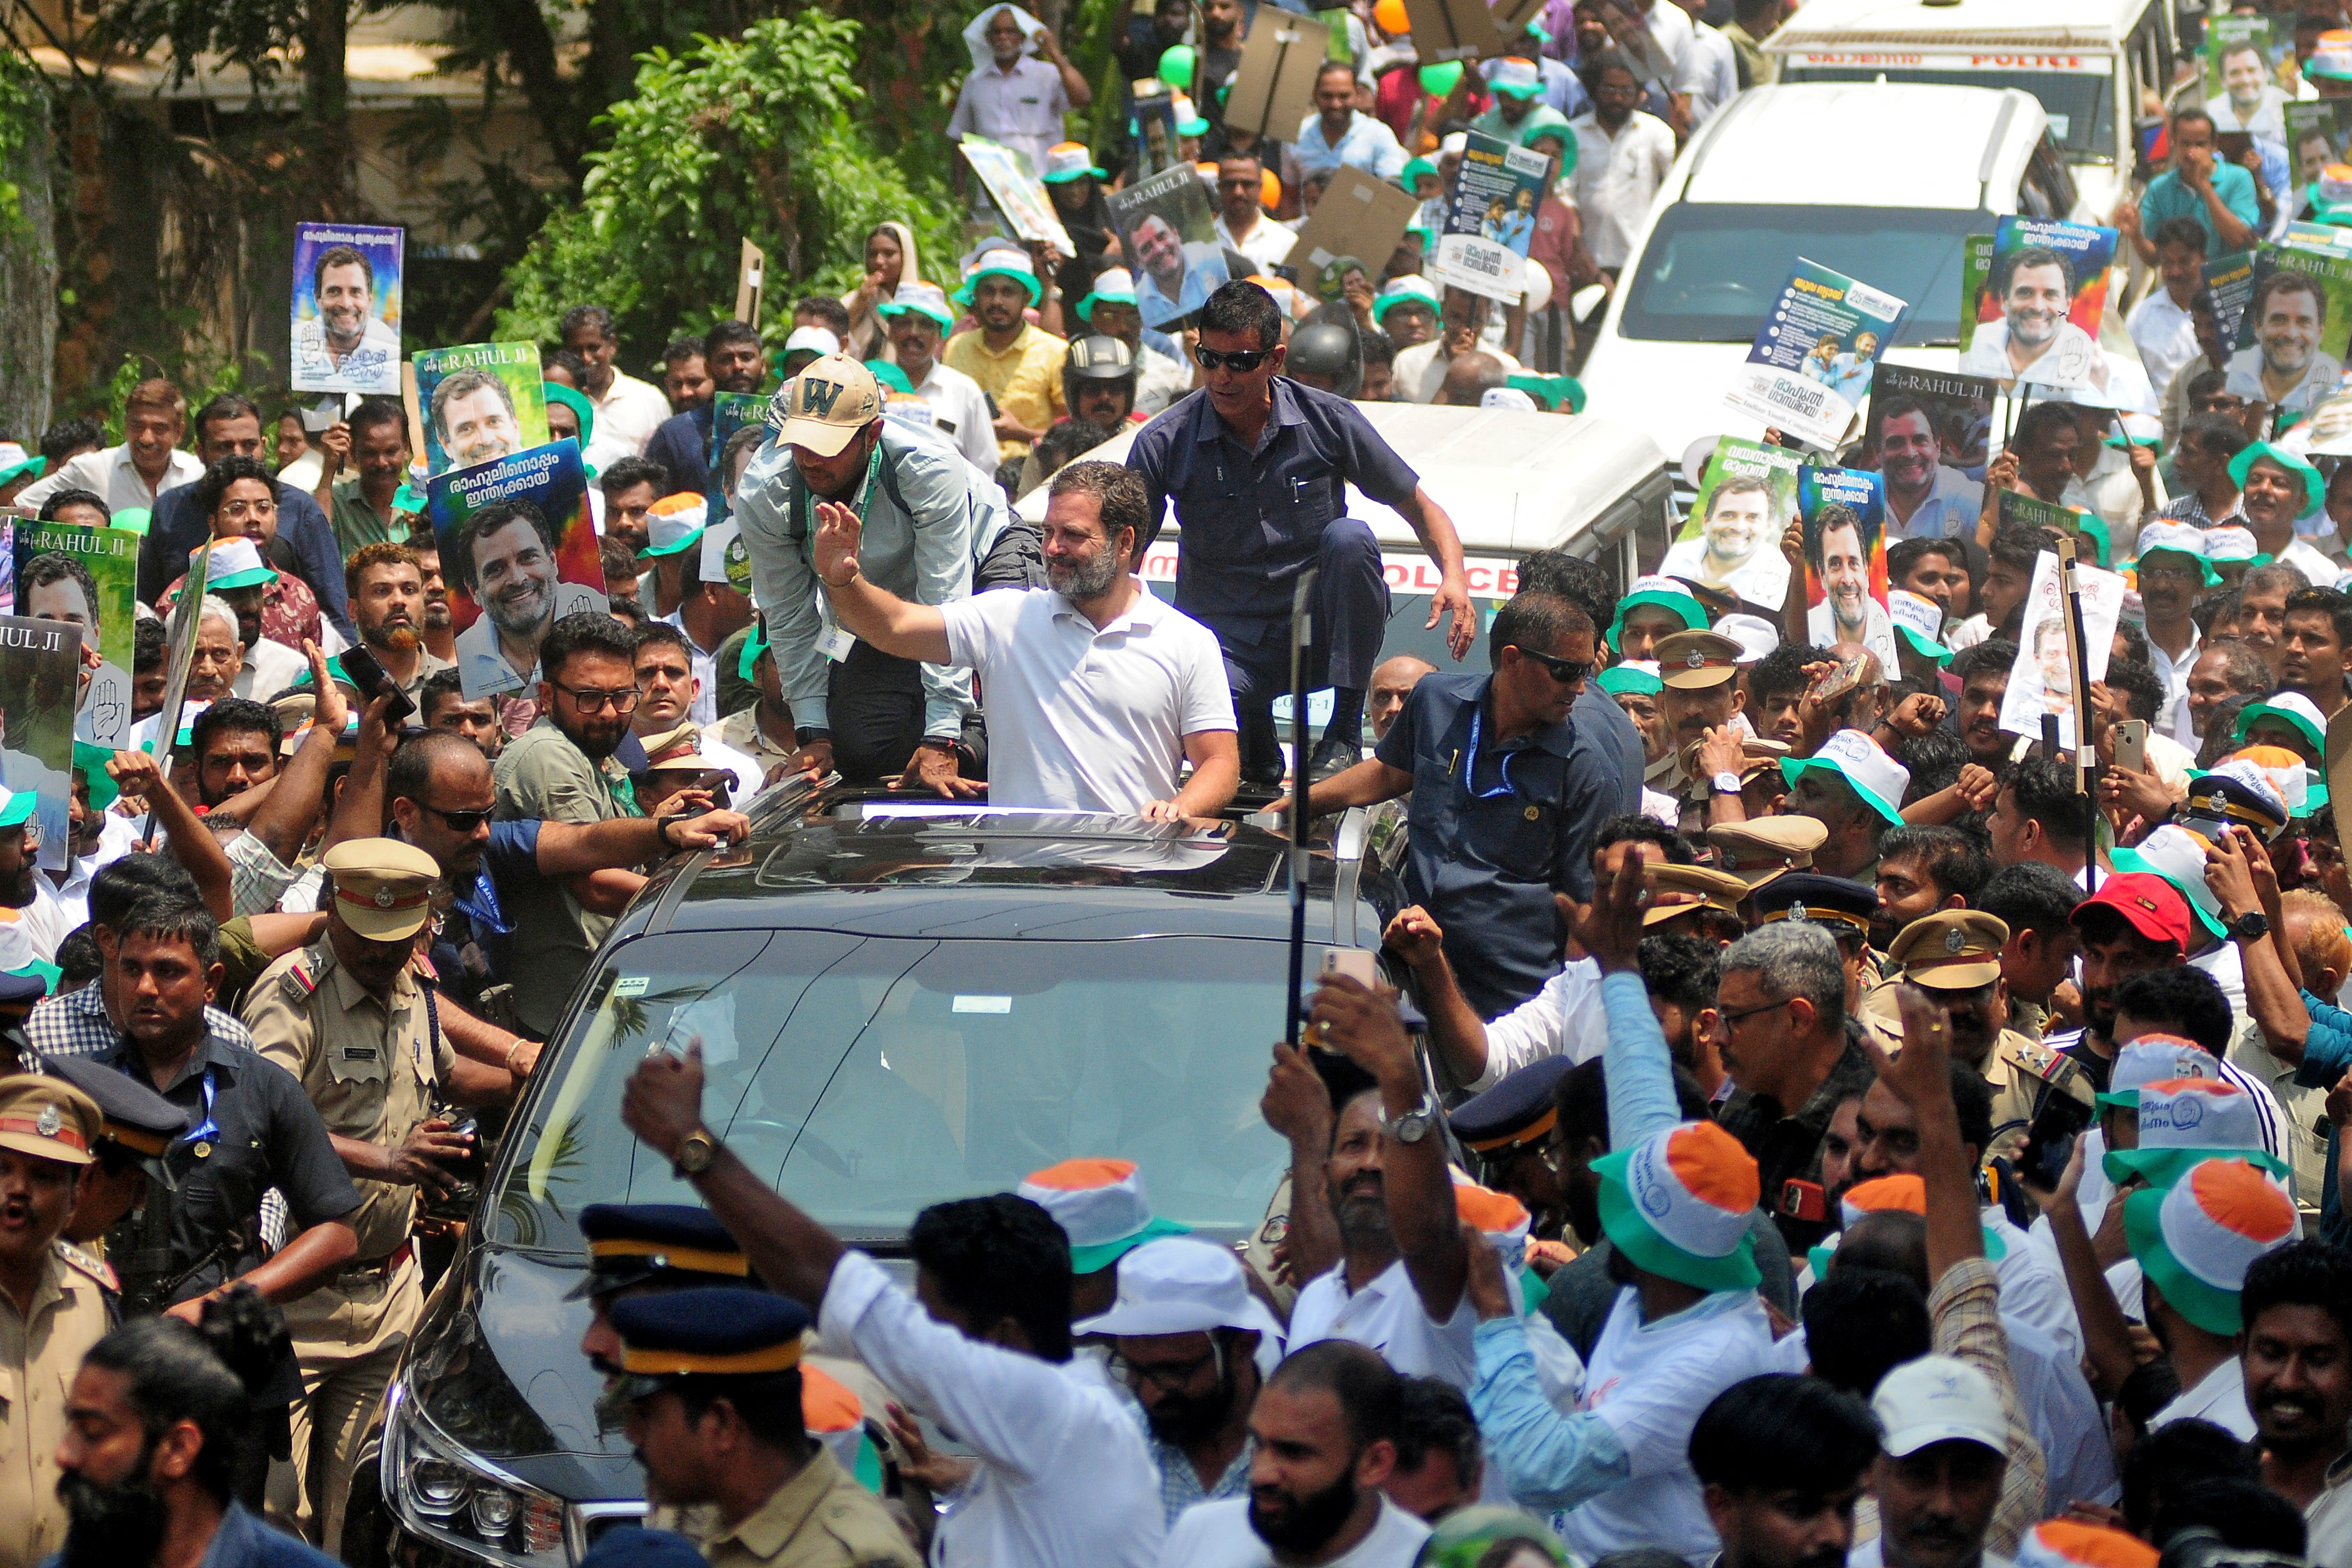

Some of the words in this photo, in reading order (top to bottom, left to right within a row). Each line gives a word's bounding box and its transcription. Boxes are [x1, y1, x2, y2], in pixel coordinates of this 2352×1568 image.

[1134, 177, 1178, 204] RAHUL
[1179, 172, 1188, 185] JI
[2286, 254, 2338, 278] RAHUL
[1850, 289, 1863, 304] 25
[448, 349, 511, 369] RAHUL
[514, 348, 527, 363] JI
[803, 377, 844, 416] W
[1773, 377, 1825, 407] രാഹുൽ
[1909, 375, 1968, 396] RAHUL
[1971, 384, 1984, 399] JI
[1743, 400, 1766, 414] Indian
[449, 453, 559, 494] രാഹുലിനൊപ്പം
[1721, 459, 1771, 479] രാഹുൽ
[41, 531, 106, 554] RAHUL
[109, 538, 125, 556] JI
[1383, 564, 1519, 594] OLCE
[0, 626, 38, 649] UL
[42, 631, 61, 652] JI
[454, 900, 476, 915] (MHA)
[482, 887, 494, 904] CRPF
[199, 1121, 213, 1134] VIP
